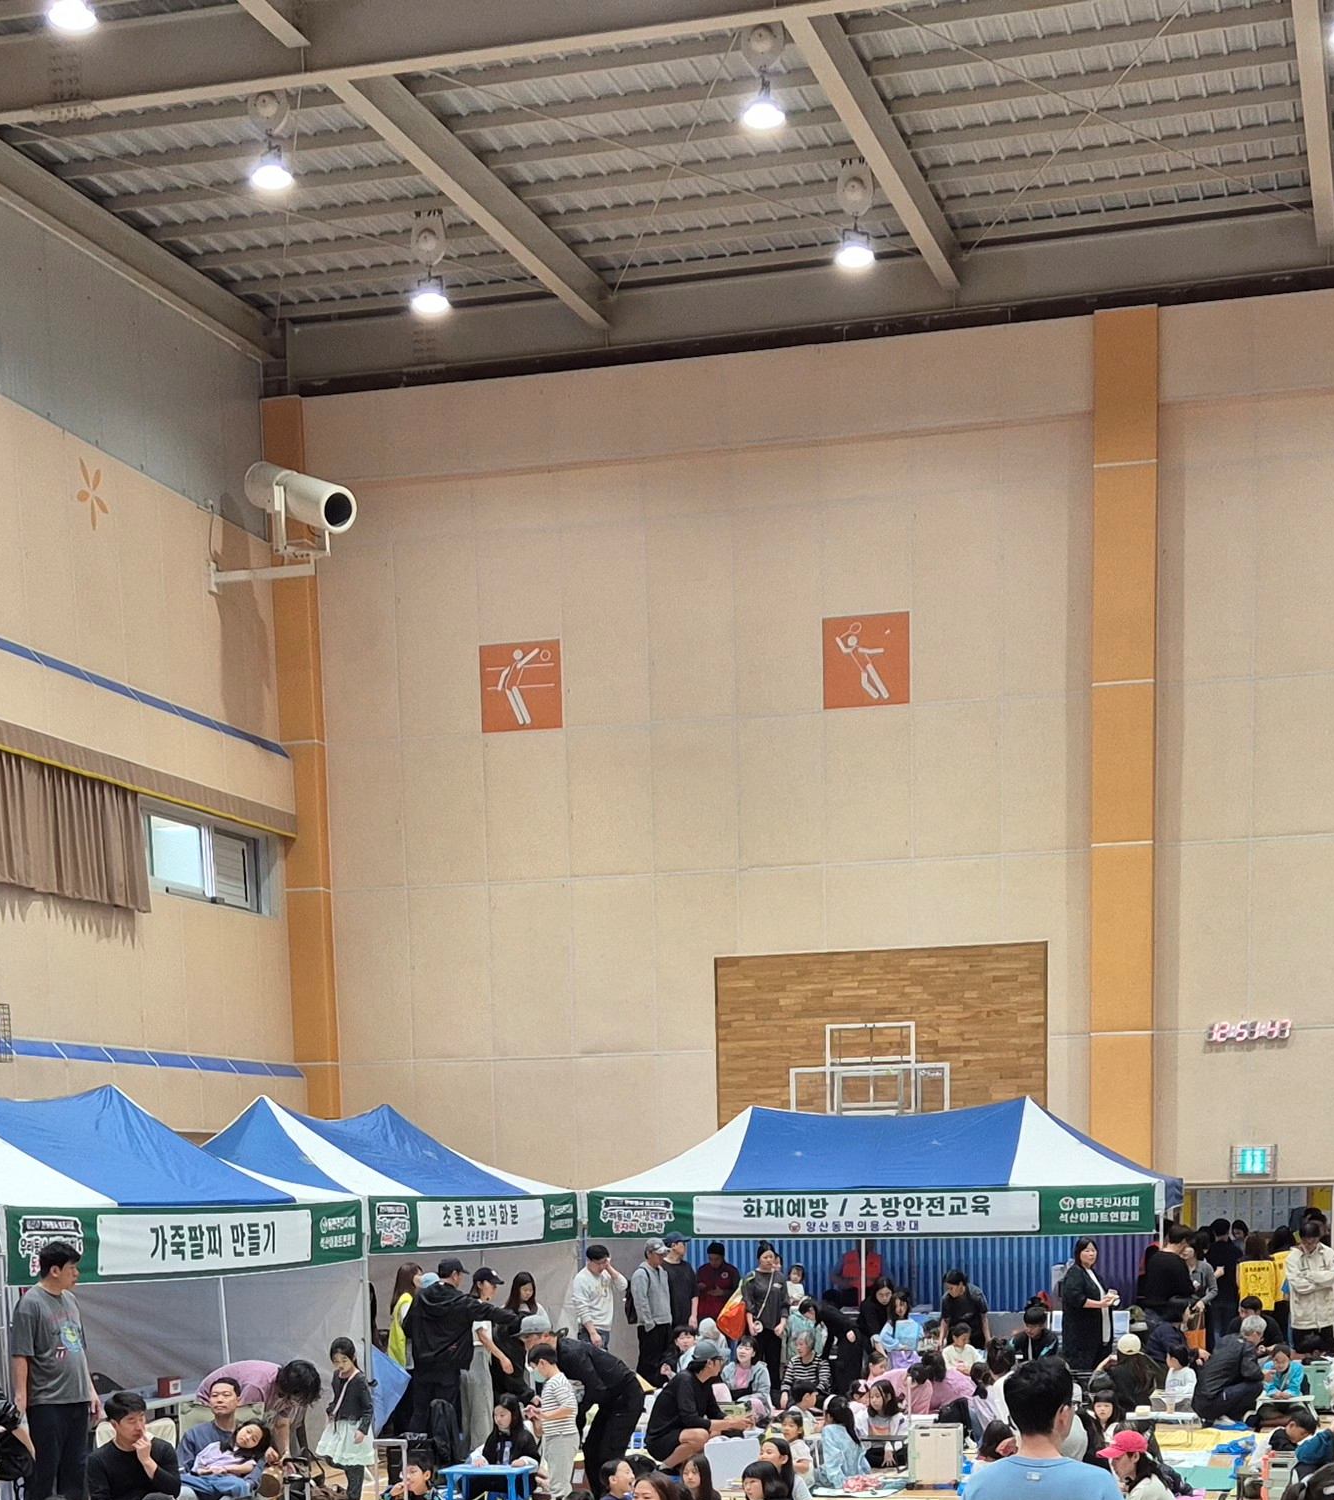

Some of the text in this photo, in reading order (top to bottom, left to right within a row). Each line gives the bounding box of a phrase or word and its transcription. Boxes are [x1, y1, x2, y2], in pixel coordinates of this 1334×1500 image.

[442, 1203, 519, 1227] 초록빛보석화분
[743, 1195, 991, 1219] 화재예방 / 소방안전교육
[149, 1221, 278, 1263] 가죽팔찌 만들기
